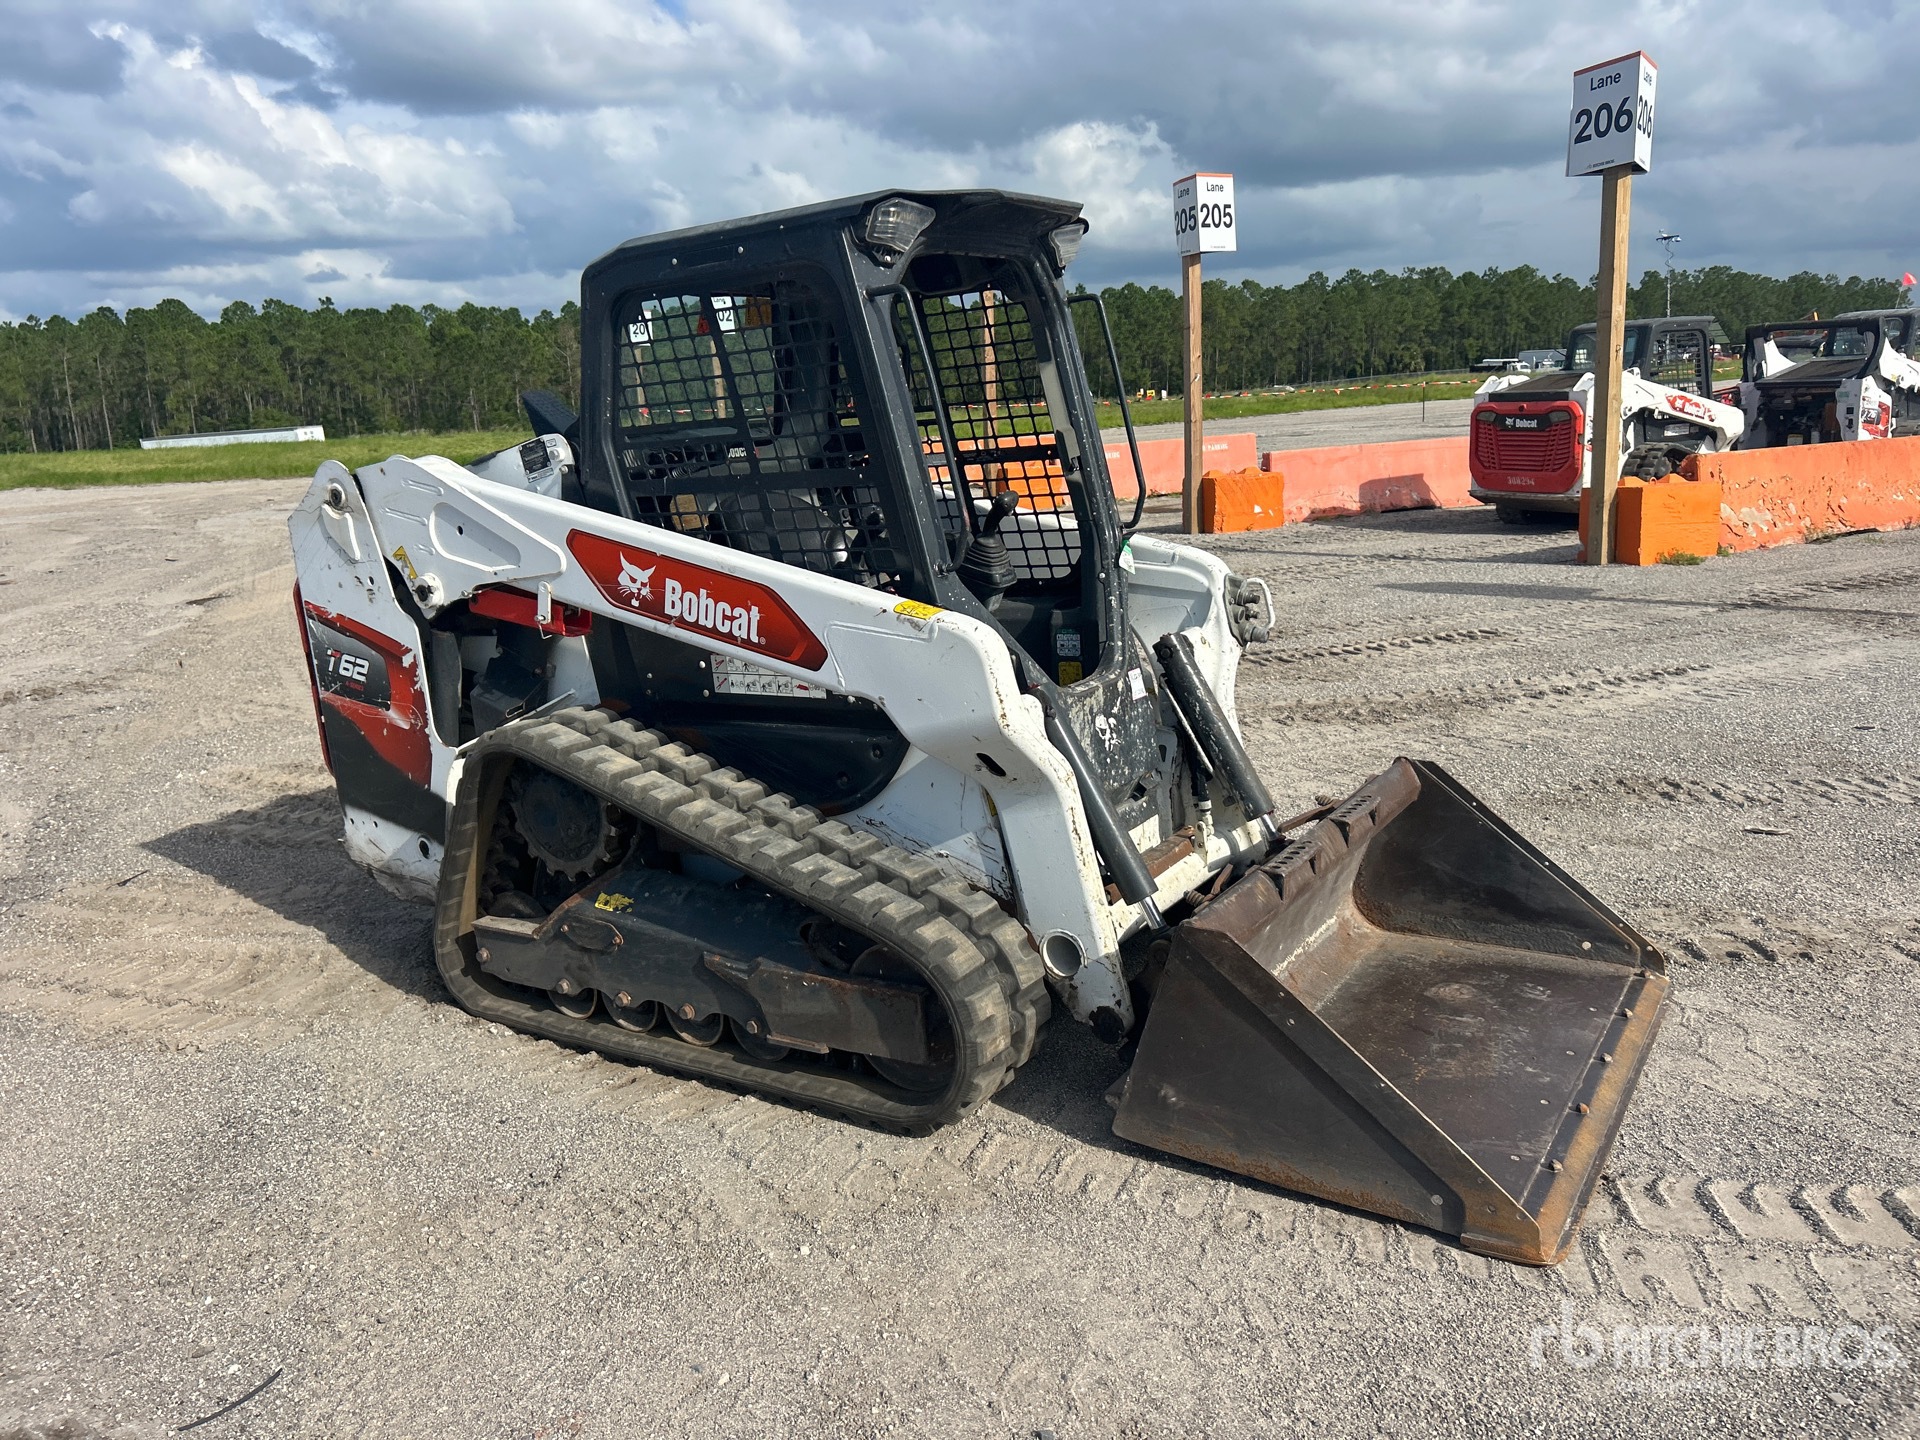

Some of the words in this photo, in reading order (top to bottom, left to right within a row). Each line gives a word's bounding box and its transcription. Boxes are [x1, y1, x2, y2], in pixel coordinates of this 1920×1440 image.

[1590, 72, 1622, 91] Lane
[1643, 66, 1653, 86] Lane
[1574, 96, 1634, 145] 206
[1637, 95, 1653, 139] 206
[1177, 187, 1190, 199] Lane
[1206, 182, 1224, 192] Lane
[1174, 205, 1197, 236] 205
[1200, 203, 1233, 228] 205
[716, 310, 733, 322] 02
[632, 323, 648, 335] 20
[1515, 417, 1537, 428] Bobcat
[664, 578, 761, 644] Bobcat
[326, 649, 370, 682] T62
